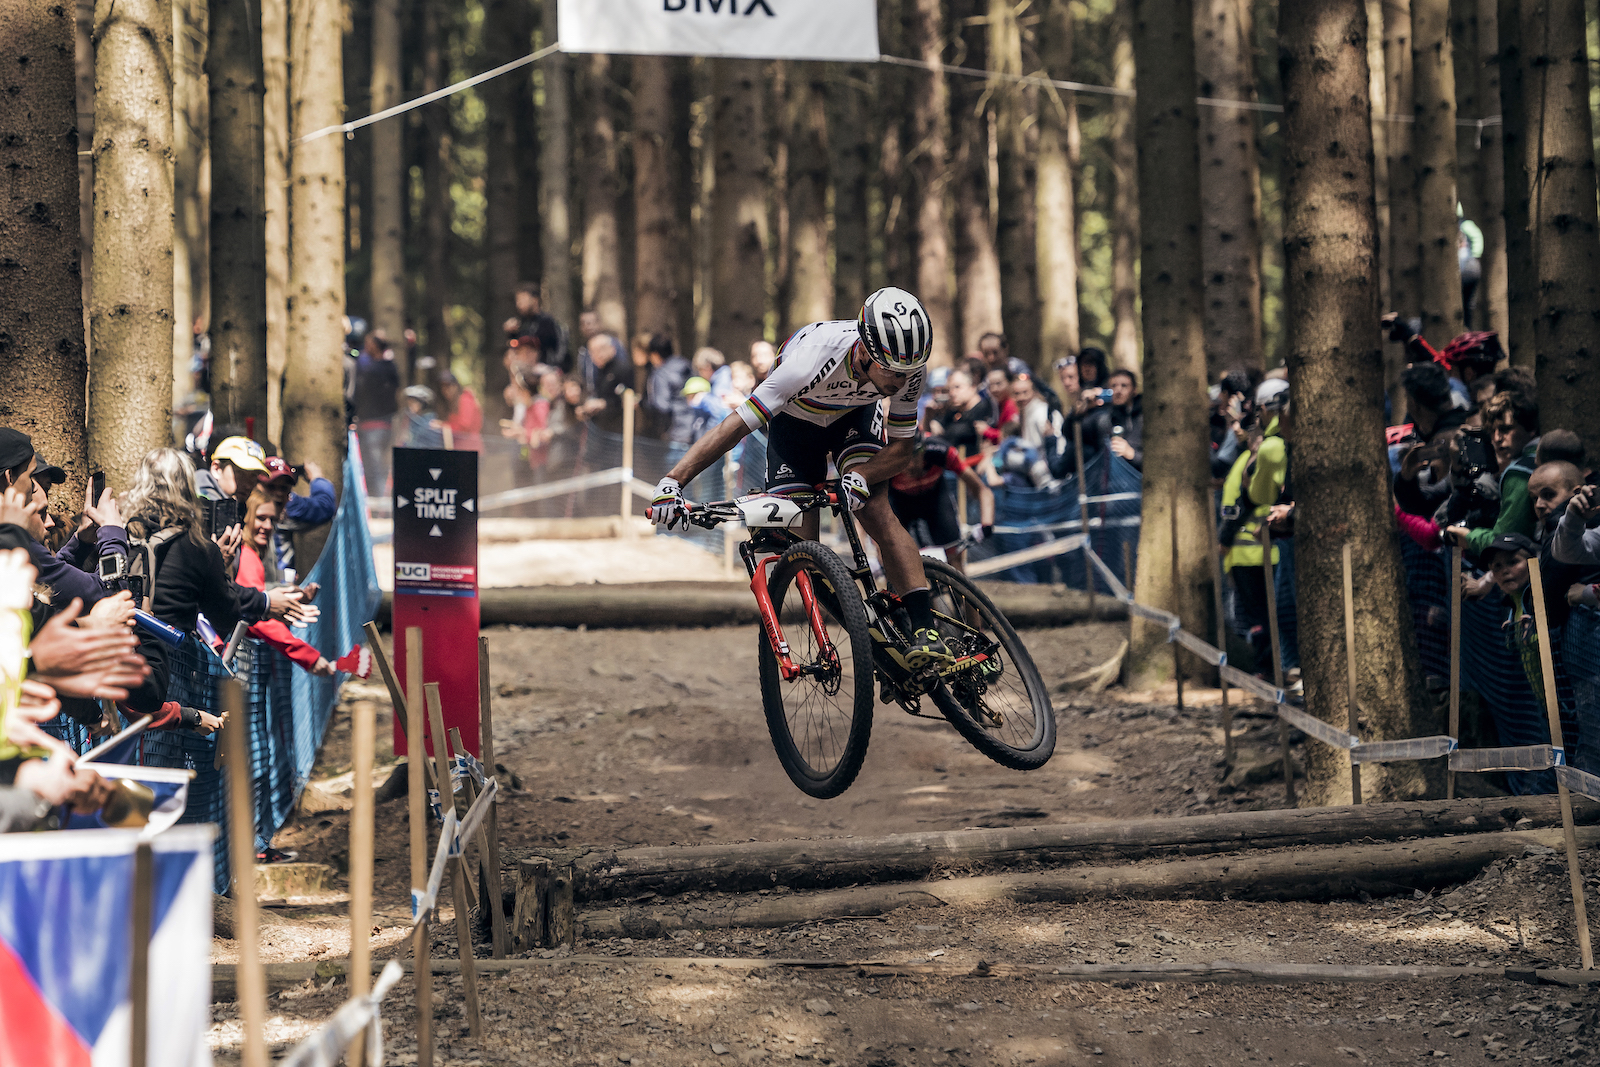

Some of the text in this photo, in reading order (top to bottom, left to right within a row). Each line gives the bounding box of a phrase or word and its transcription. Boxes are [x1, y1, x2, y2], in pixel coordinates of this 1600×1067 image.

[829, 380, 852, 390] UCI
[414, 487, 458, 504] SPLIT
[414, 503, 457, 520] TIME
[762, 502, 783, 522] 2
[402, 566, 428, 577] UCI
